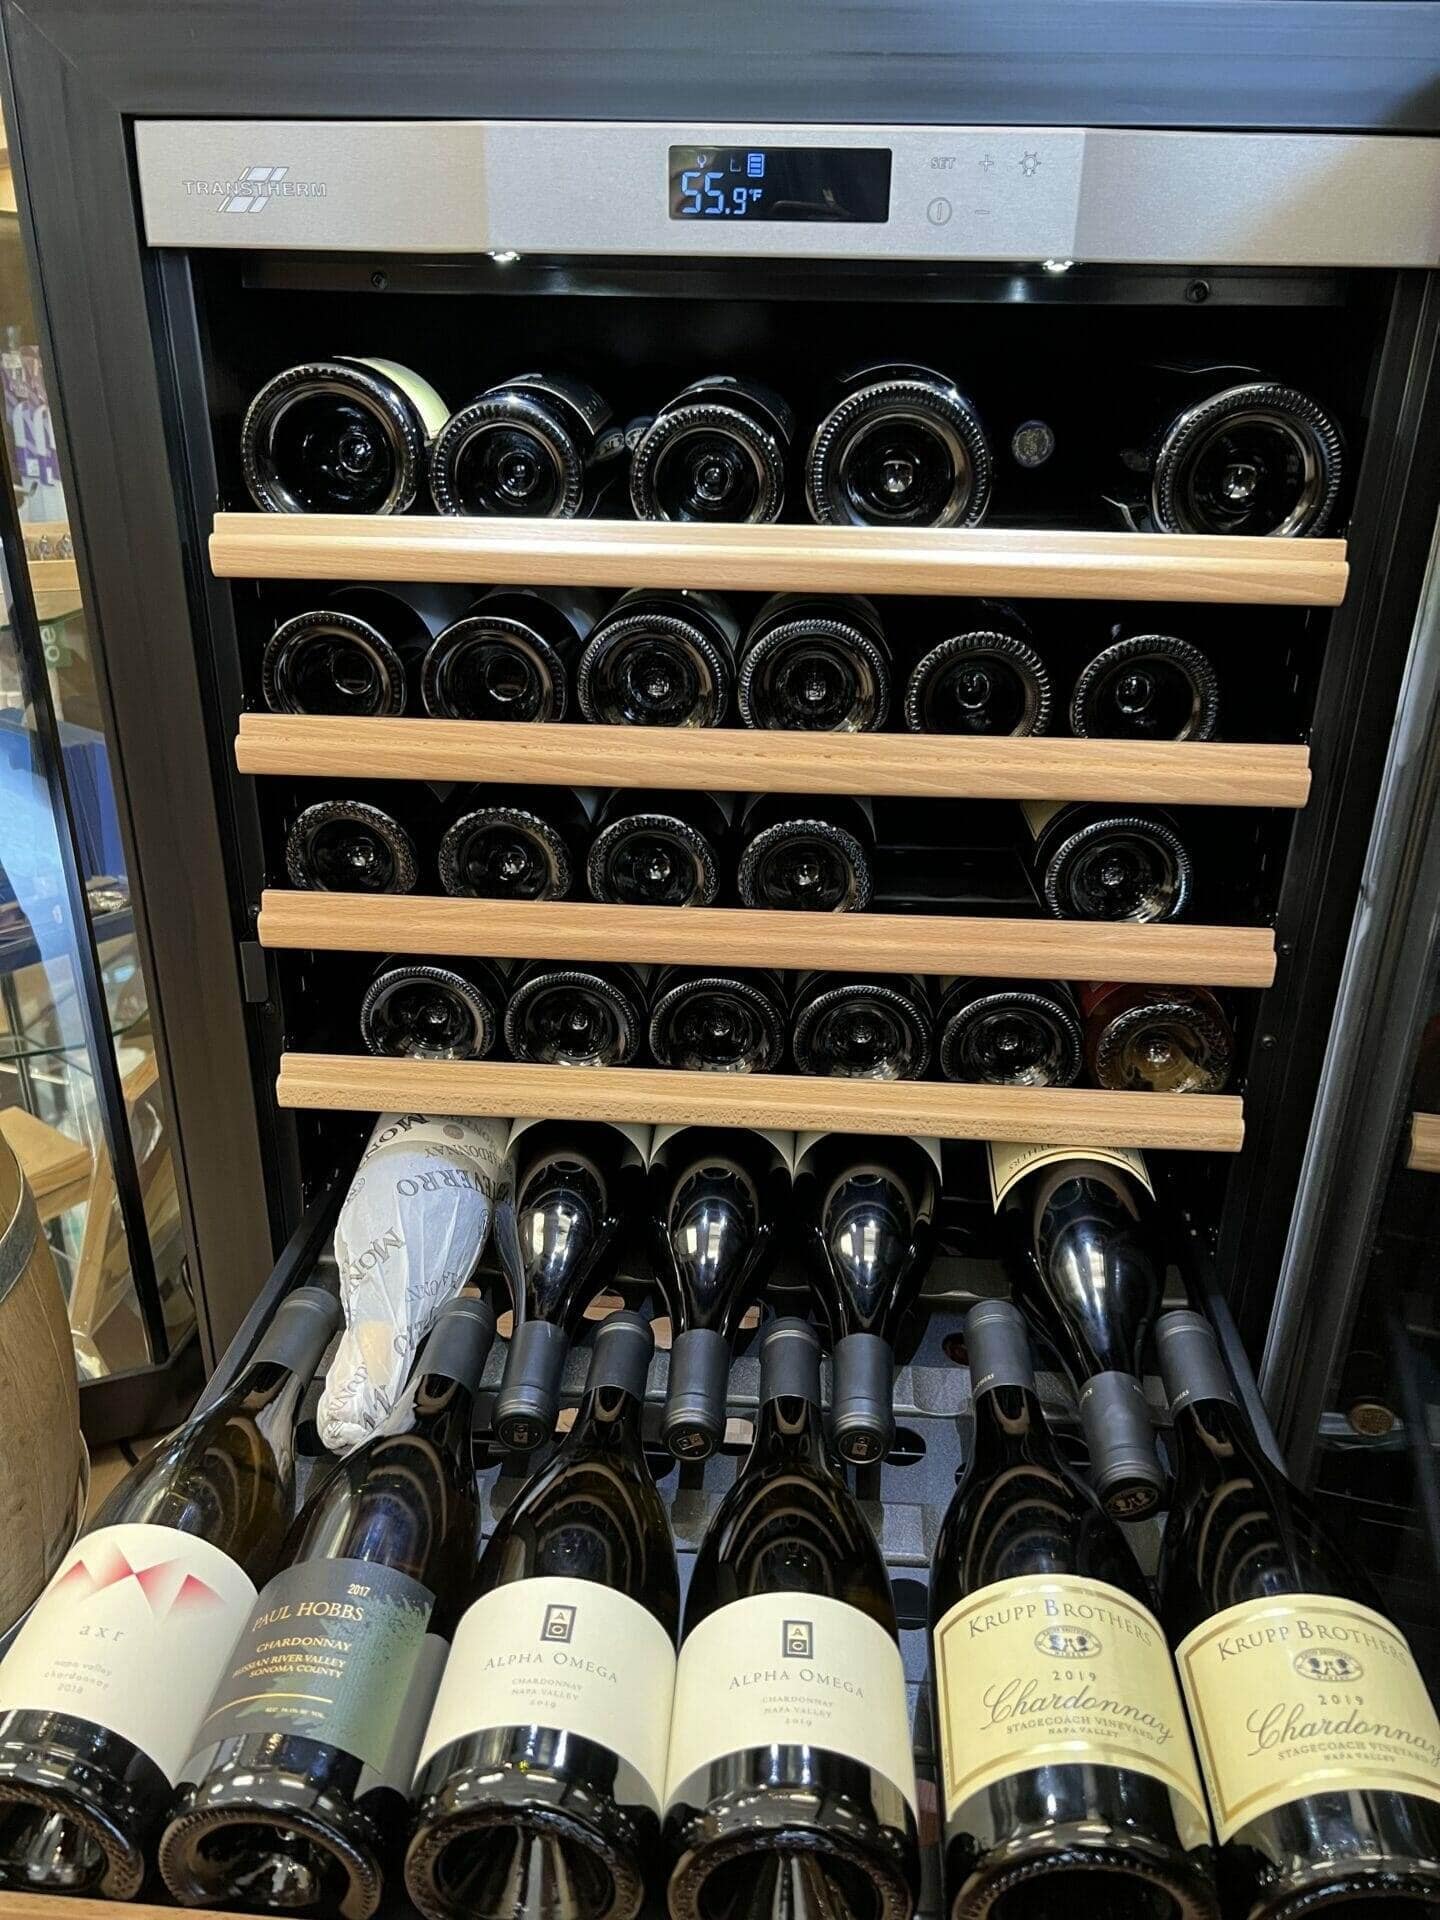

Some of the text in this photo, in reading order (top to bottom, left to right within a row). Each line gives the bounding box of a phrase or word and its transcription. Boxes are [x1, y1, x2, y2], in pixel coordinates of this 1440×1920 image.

[930, 157, 956, 169] SET
[182, 179, 327, 197] TRANSTHERM
[347, 1582, 372, 1598] 2017
[252, 1601, 365, 1632] PAUL HOBBS
[968, 1598, 1152, 1648] KRUPP BROTHERS
[256, 1636, 352, 1653] CHARDONNAY
[1217, 1619, 1408, 1667] KRUPP BROTHERS
[270, 1653, 304, 1665] RIVER
[304, 1653, 347, 1669] VALLEY
[483, 1651, 618, 1684] ALPHA OMEGA
[248, 1663, 344, 1679] SONOMA COUNTY
[1053, 1670, 1098, 1683] 2019
[511, 1676, 583, 1691] CHARDONNAY
[728, 1668, 865, 1699] ALPHA OMEGA
[511, 1687, 580, 1702] NAPA VALLEY
[762, 1694, 834, 1708] CHARDONNAY
[1318, 1694, 1364, 1706] 2019
[980, 1678, 1174, 1746] Chardonnay
[1006, 1714, 1154, 1742] STAGECOACH VINEYARD
[1048, 1726, 1120, 1739] NAPA VALLEY
[1246, 1702, 1440, 1768] Chardonnay
[1277, 1740, 1430, 1764] STAGECOACH VINEYARD
